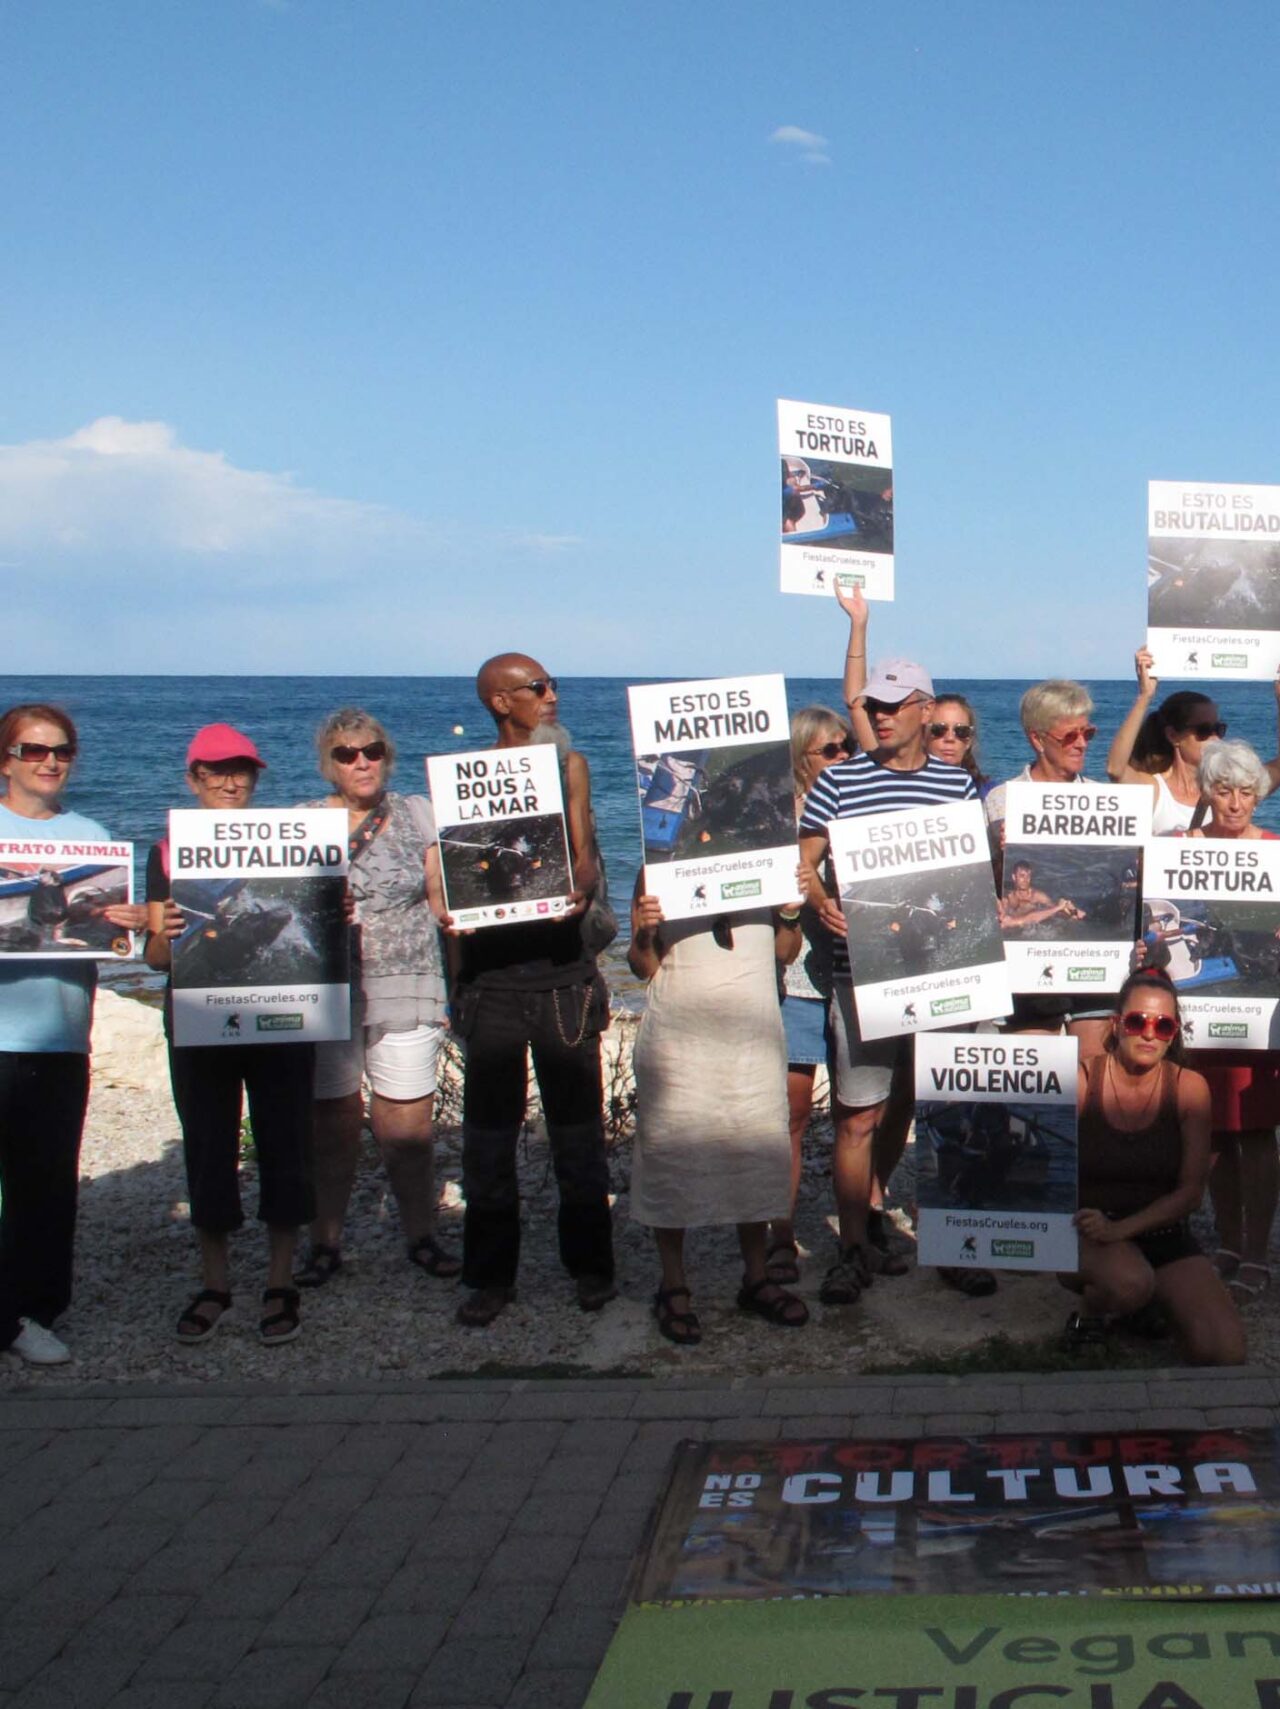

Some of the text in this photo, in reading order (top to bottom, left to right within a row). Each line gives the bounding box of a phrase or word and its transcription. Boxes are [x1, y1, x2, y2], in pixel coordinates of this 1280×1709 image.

[807, 414, 867, 436] ESTO ES
[795, 430, 879, 459] TORTURA
[1182, 492, 1254, 509] ESTO ES
[1154, 510, 1280, 533] BRUTALIDAD
[669, 690, 751, 714] ESTO ES
[654, 710, 770, 743] MARTIRIO
[456, 757, 531, 780] NO ALS
[456, 778, 536, 800] BOUS A
[458, 795, 538, 820] LA MAR
[1042, 794, 1119, 811] ESTO ES
[214, 822, 306, 840] ESTO ES
[868, 817, 948, 843] ESTO ES
[1022, 814, 1137, 836] BARBARIE
[61, 845, 130, 857] ANIMAL
[178, 845, 342, 868] BRUTALIDAD
[846, 833, 976, 872] TORMENTO
[1180, 850, 1258, 867] ESTO ES
[675, 858, 773, 878] FiestasCrueles.org
[1164, 869, 1273, 892] TORTURA
[1027, 947, 1120, 959] FiestasCrueles.org
[883, 975, 981, 997] FiestasCrueles.org
[206, 993, 318, 1005] FiestasCrueles.org
[954, 1047, 1039, 1066] ESTO ES
[931, 1068, 1062, 1094] VIOLENCIA
[946, 1216, 1048, 1232] FiestasCrueles.org
[776, 1433, 1250, 1475] TORTURA
[704, 1473, 762, 1490] NO
[781, 1461, 1258, 1505] CULTURA
[698, 1493, 754, 1509] ES
